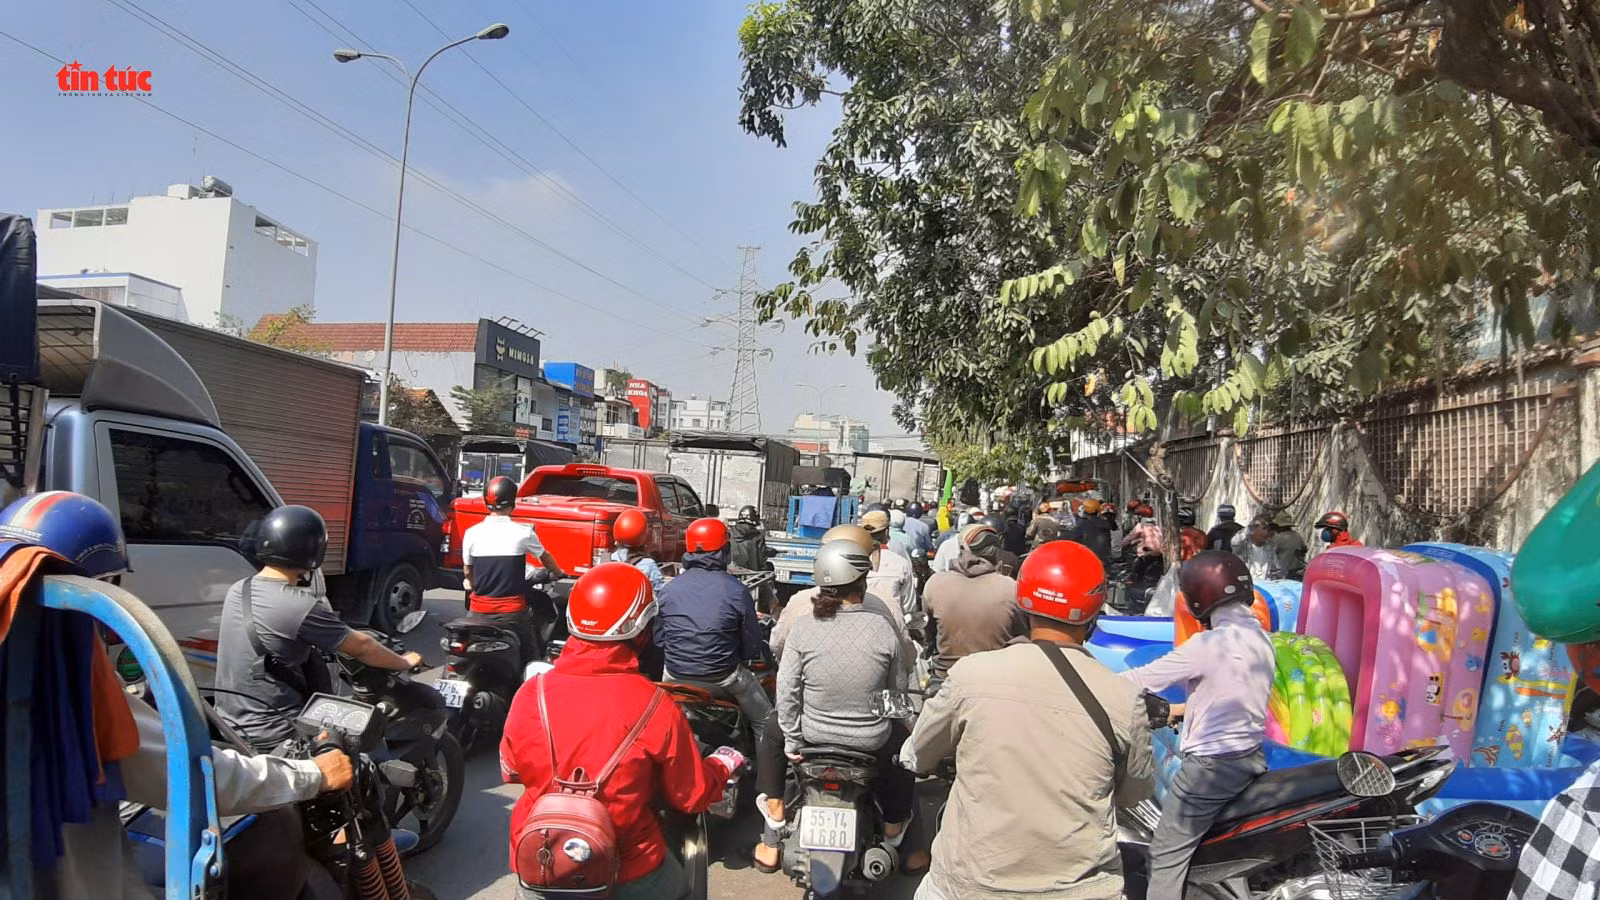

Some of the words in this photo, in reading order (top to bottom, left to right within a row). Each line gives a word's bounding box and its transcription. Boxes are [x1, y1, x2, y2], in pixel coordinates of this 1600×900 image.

[508, 346, 534, 365] MIMOSA
[810, 810, 847, 828] 55-Y4
[810, 828, 846, 848] 1680
